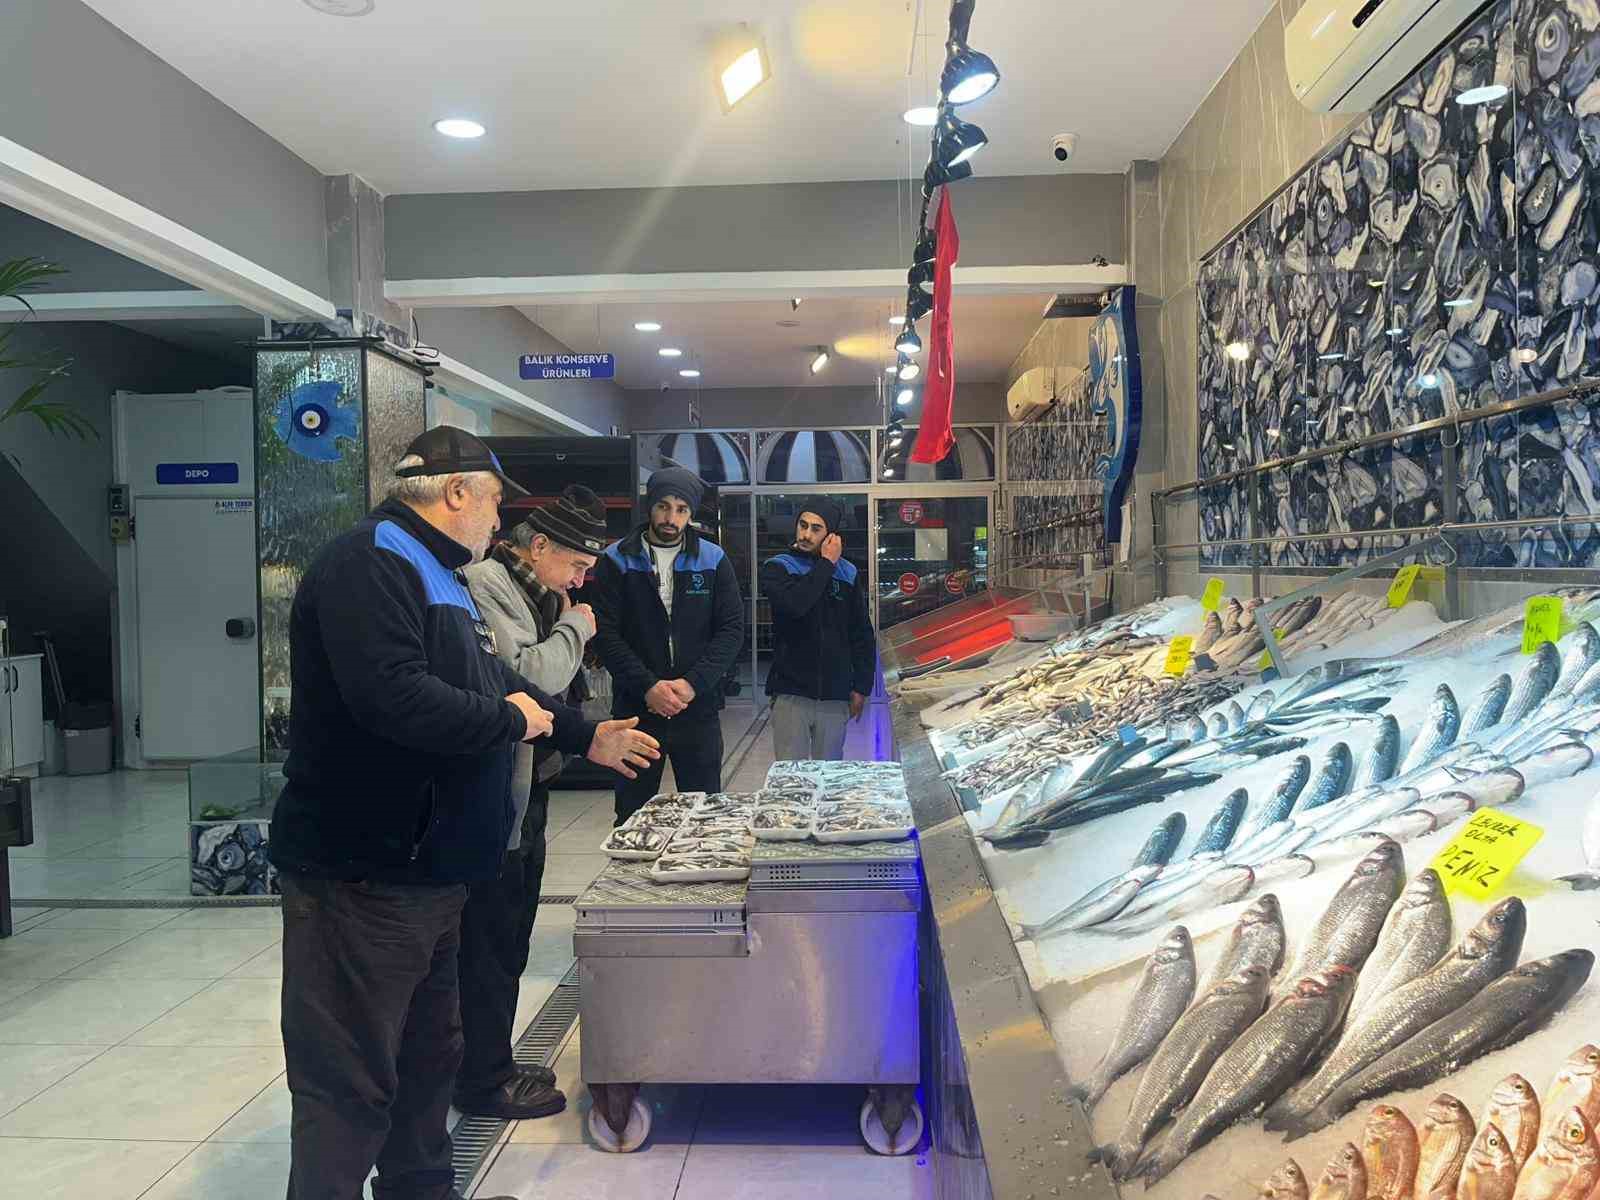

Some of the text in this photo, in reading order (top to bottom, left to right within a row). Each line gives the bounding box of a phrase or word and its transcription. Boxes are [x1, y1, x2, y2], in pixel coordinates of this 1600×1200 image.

[525, 354, 609, 364] BALIK KONSERVE
[542, 367, 591, 378] ÜRÜNLERİ
[185, 470, 209, 478] DEPO
[1440, 845, 1500, 887] DENİZ
